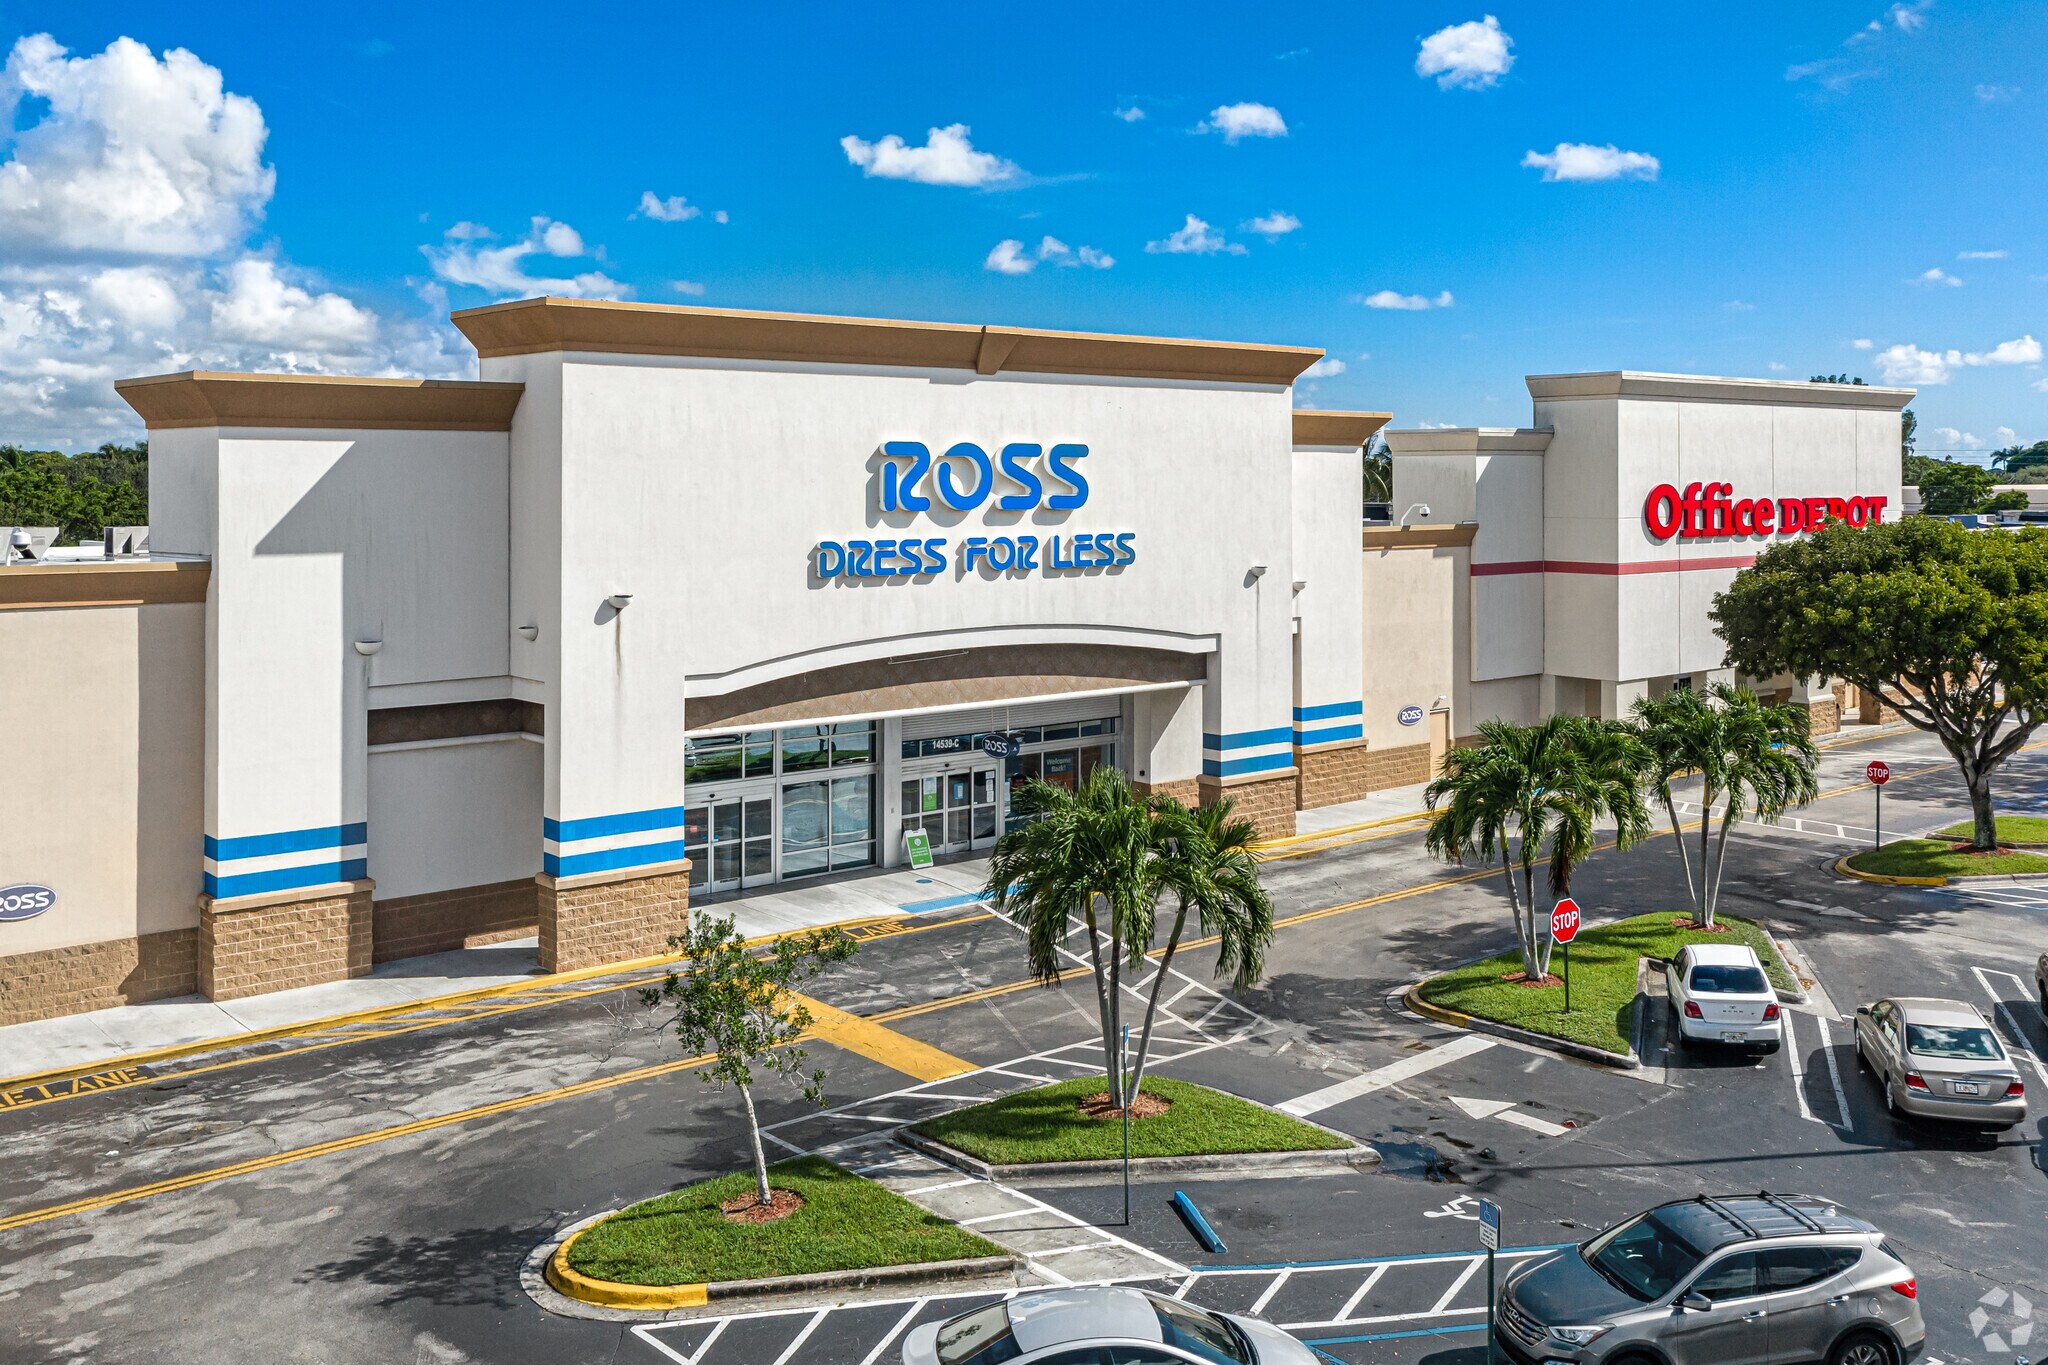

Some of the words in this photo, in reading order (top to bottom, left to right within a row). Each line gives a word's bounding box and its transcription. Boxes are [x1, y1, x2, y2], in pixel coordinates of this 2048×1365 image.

[879, 441, 1089, 512] ROSS
[1645, 482, 1775, 539] Office
[817, 538, 947, 578] DRESS
[963, 535, 1038, 572] FOR
[1050, 533, 1136, 569] LESS
[1402, 709, 1421, 720] ROSS
[933, 738, 959, 749] 14539-C
[985, 739, 1007, 753] ROSS
[1868, 767, 1888, 778] STOP
[1553, 911, 1578, 931] STOP
[842, 922, 914, 939] LANE
[38, 1068, 148, 1098] LANE
